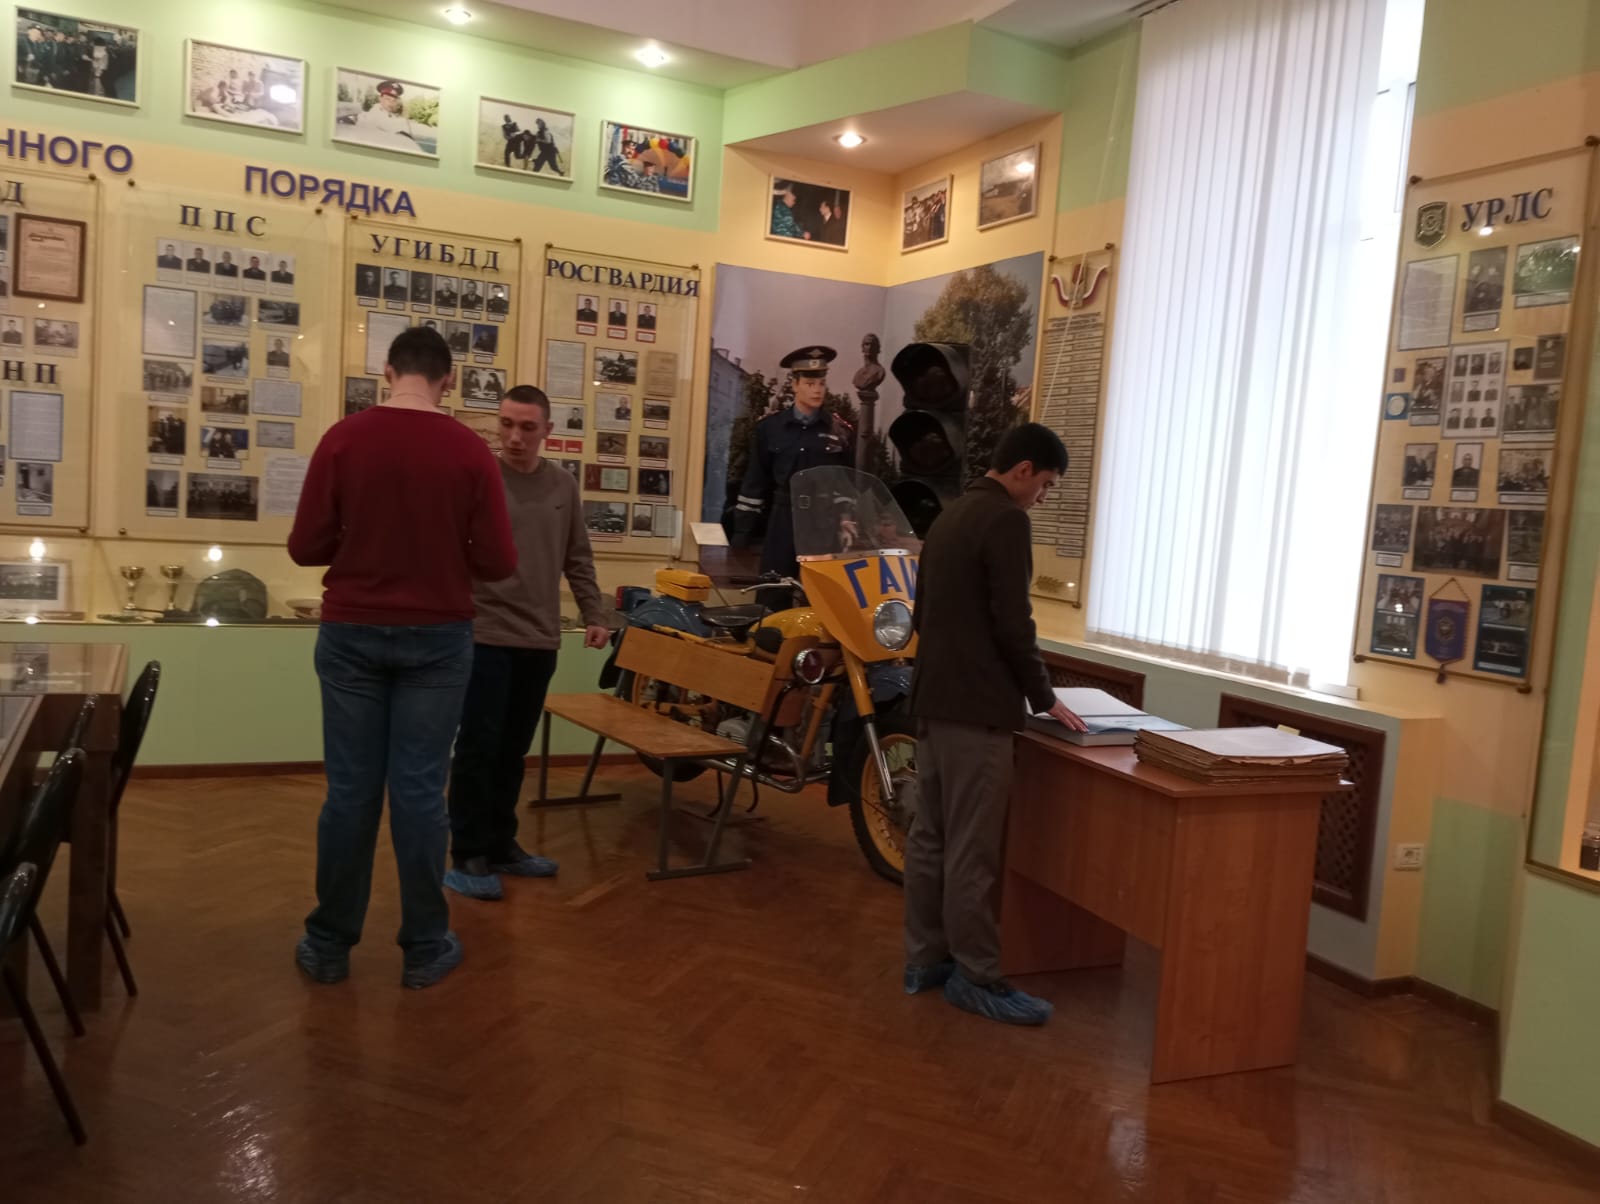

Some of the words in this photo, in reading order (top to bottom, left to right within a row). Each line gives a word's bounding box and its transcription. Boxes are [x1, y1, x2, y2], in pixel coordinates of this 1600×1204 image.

[245, 165, 416, 217] ПОРЯДКА
[1461, 188, 1554, 232] УРЛС
[180, 204, 267, 237] ППС
[370, 233, 500, 272] УГИБДД
[546, 258, 700, 298] РОСГВАРДИЯ
